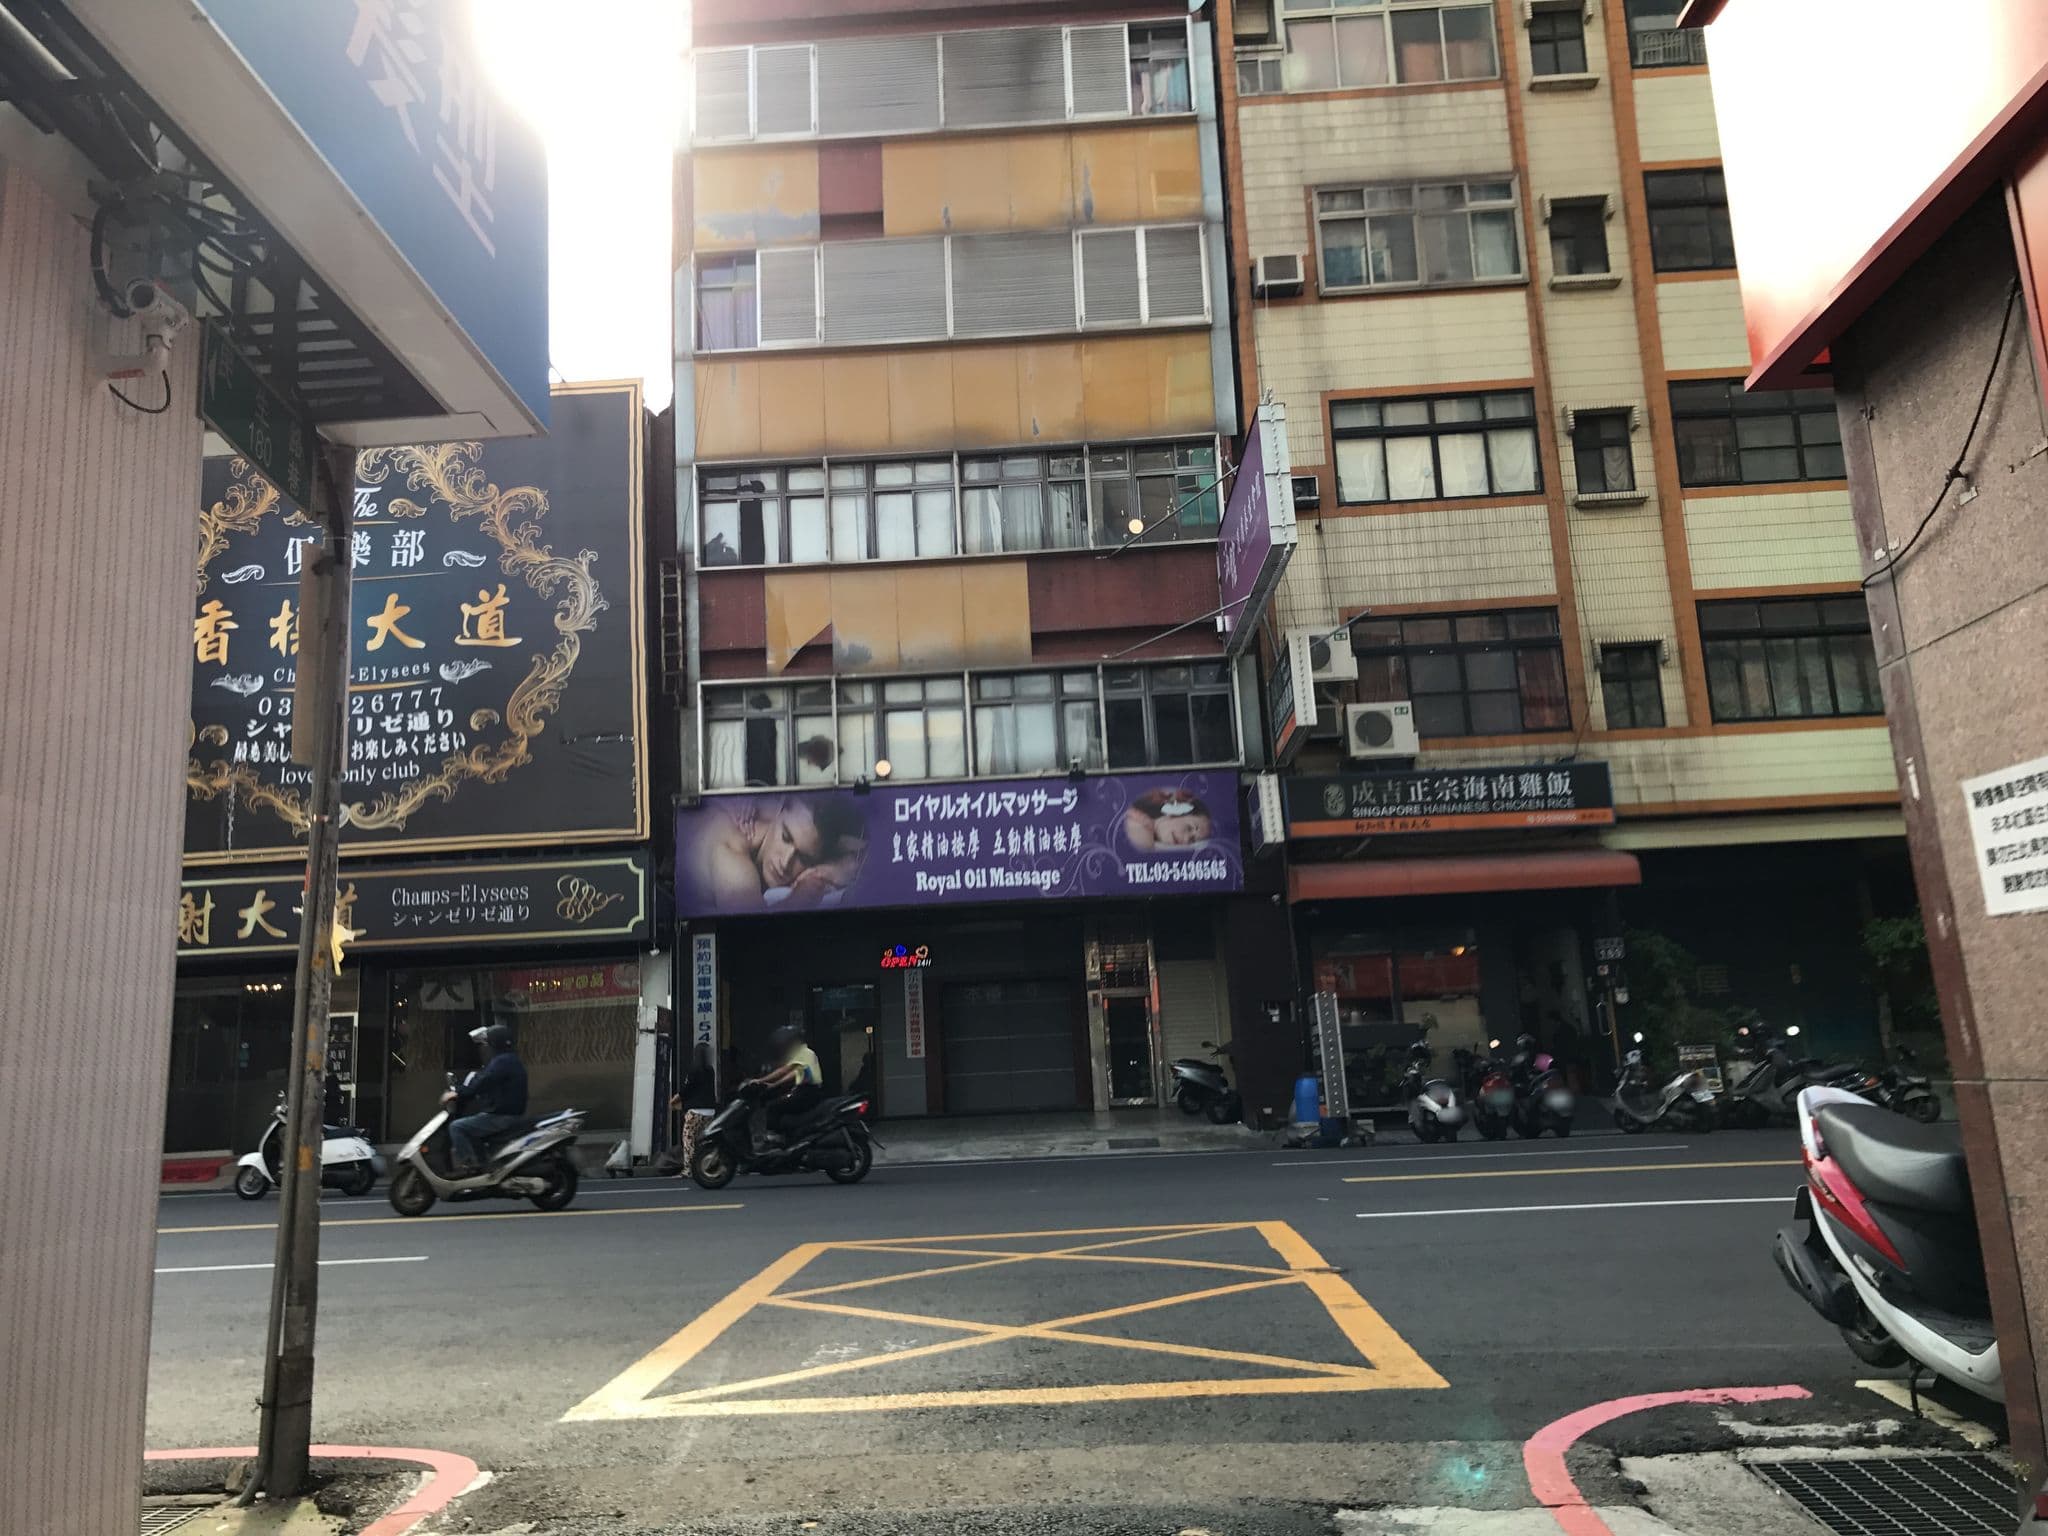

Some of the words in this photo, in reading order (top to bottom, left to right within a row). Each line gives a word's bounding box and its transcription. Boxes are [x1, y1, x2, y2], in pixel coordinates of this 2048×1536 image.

[248, 420, 272, 468] 180
[258, 687, 442, 717] 0326777
[246, 709, 454, 738] シャリゼ通り
[382, 760, 420, 780] club
[1352, 770, 1573, 805] 成吉正宗海南雞飯
[895, 788, 1078, 821] ロイヤルオイルマッサージ
[1352, 804, 1421, 818] SINGAPORE
[1423, 801, 1491, 815] HAINANESE
[1492, 798, 1545, 812] CHICKEN
[1547, 796, 1576, 809] RICE
[892, 826, 980, 863] 皇家精油按摩
[992, 822, 1082, 856] 互動精油按摩
[392, 884, 529, 907] Champs-Elysees
[916, 869, 962, 896] Royal
[964, 868, 987, 889] Oil
[989, 867, 1061, 891] Massage
[393, 904, 530, 927] シャンゼリゼ通り
[881, 954, 918, 968] OPEN
